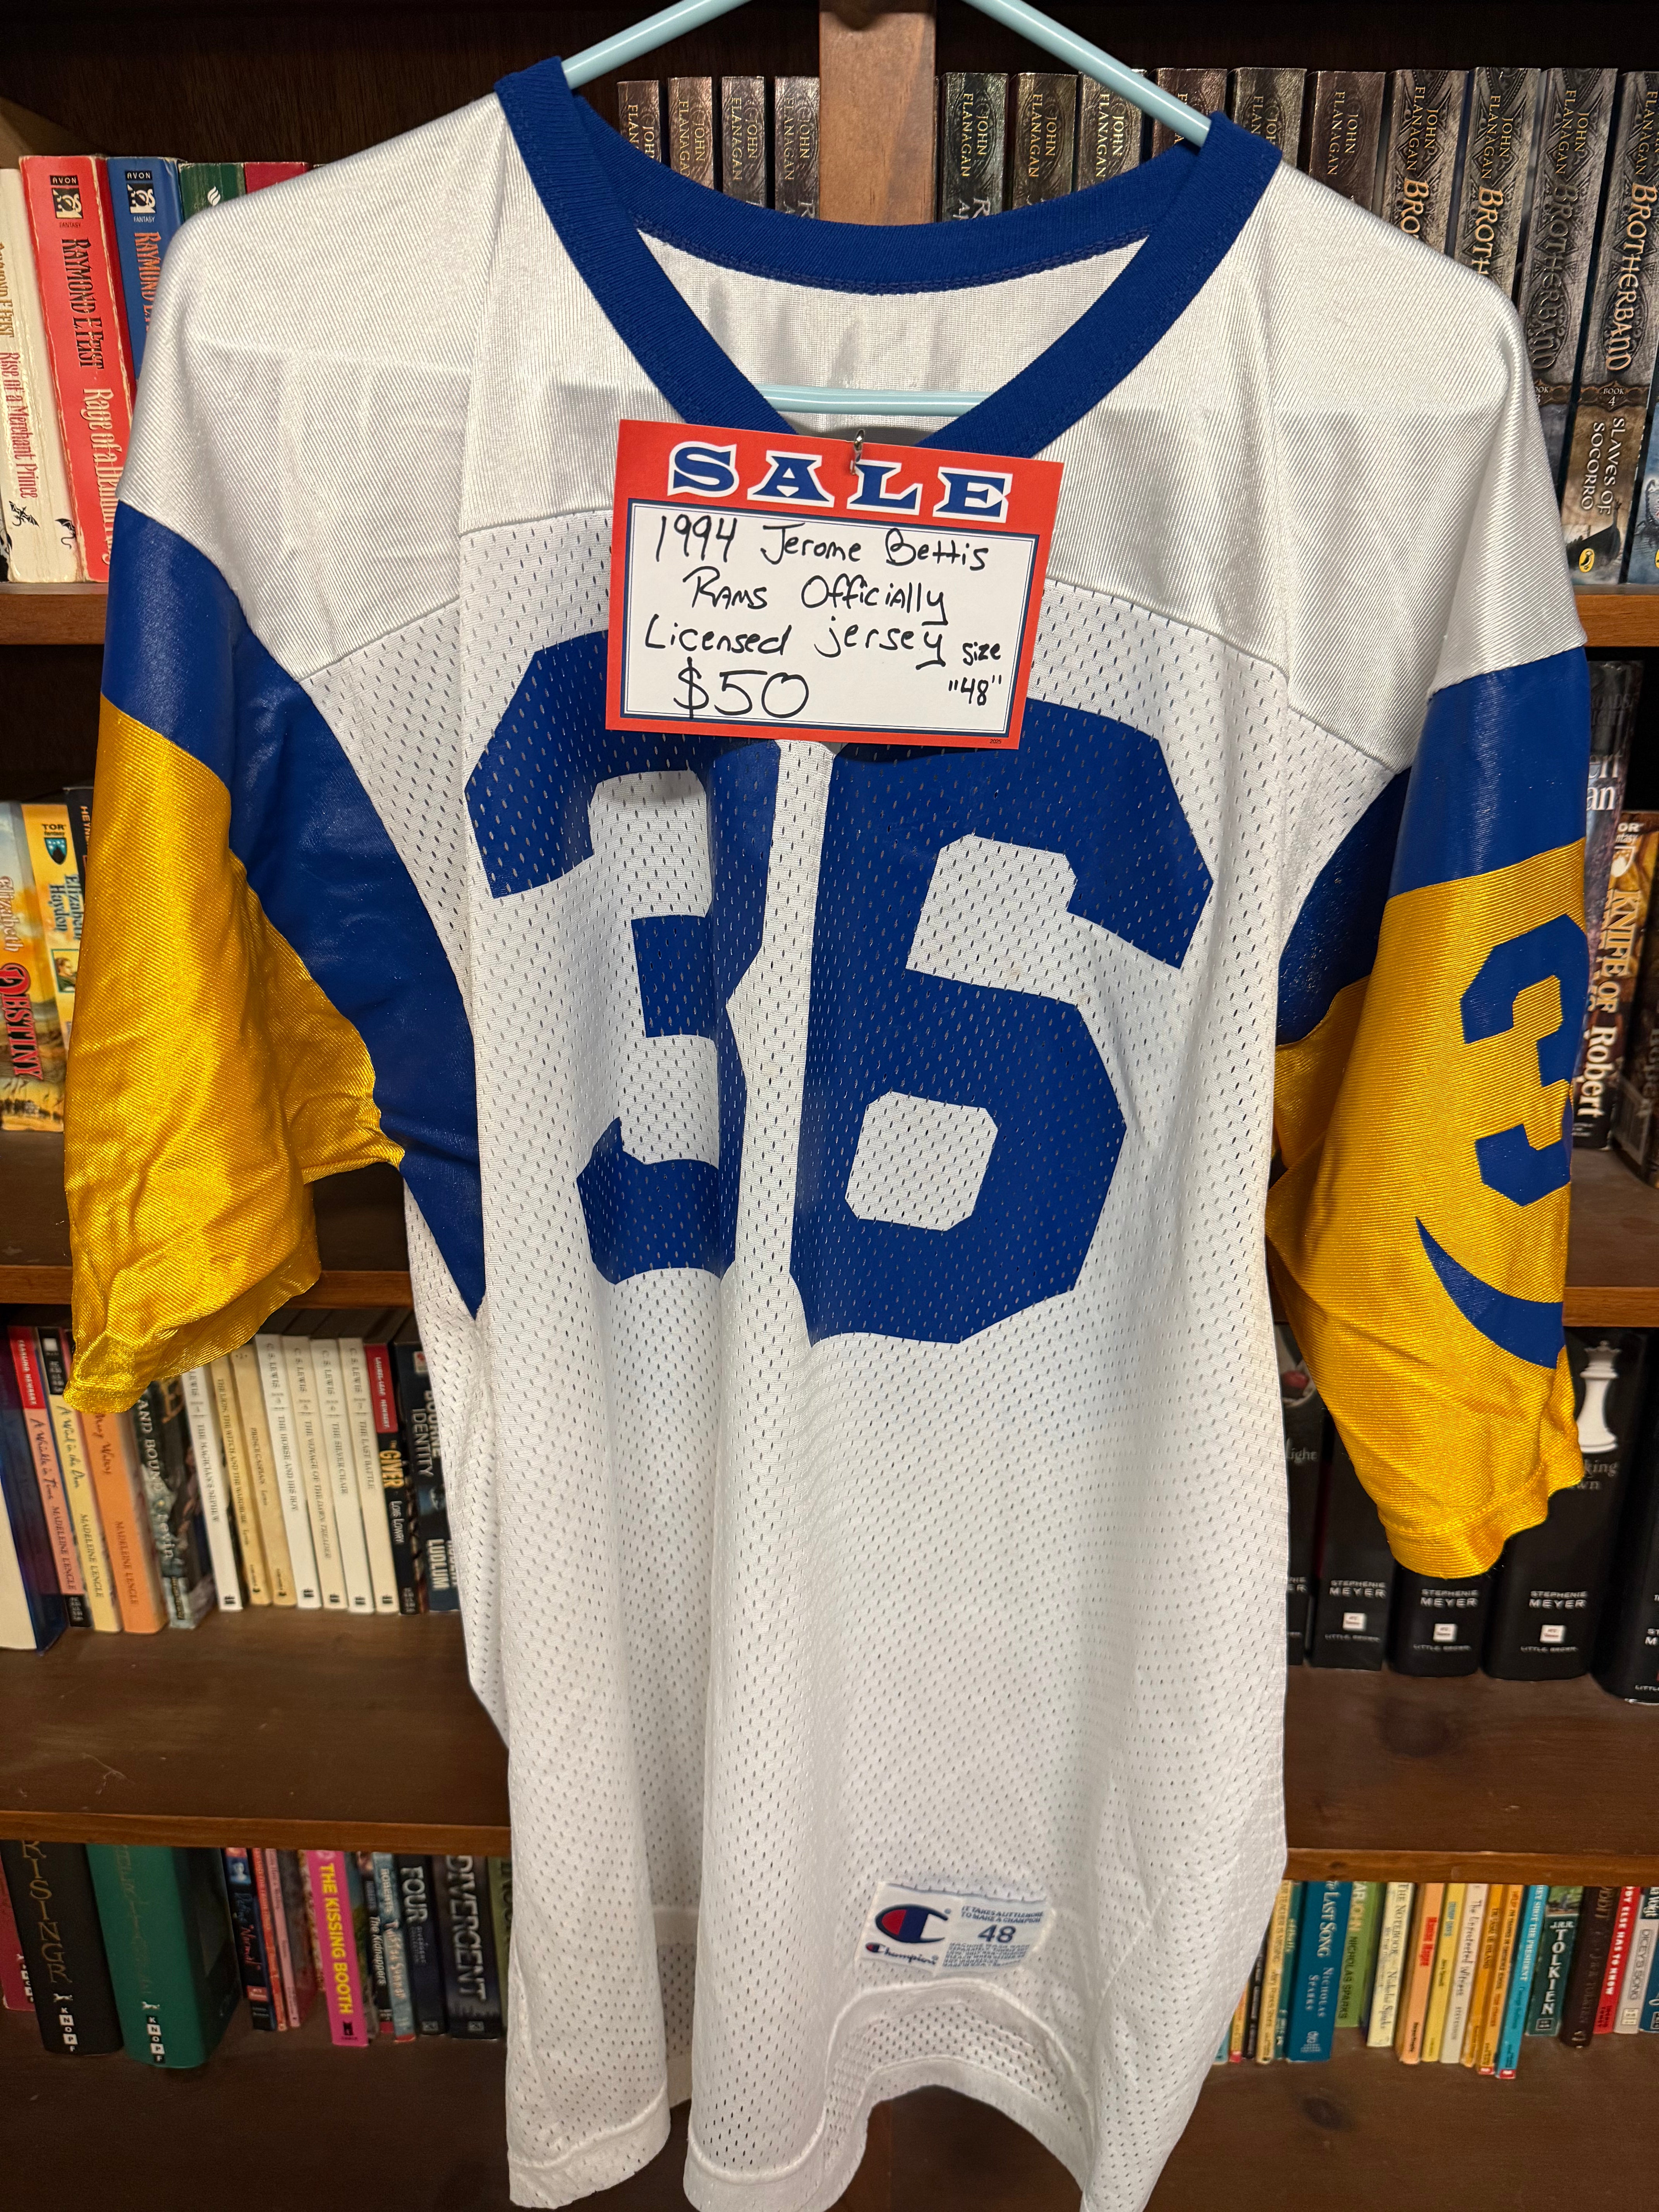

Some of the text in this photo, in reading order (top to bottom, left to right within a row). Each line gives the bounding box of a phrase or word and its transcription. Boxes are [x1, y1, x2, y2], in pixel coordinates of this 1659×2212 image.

[642, 126, 654, 159] JOH
[692, 122, 705, 161] JOHN
[731, 97, 742, 180] FLANAGAN
[745, 118, 758, 160] JOHN
[784, 98, 795, 180] FLANAGAN
[797, 118, 810, 159] JOHN
[961, 93, 973, 177] FLANAGAN
[976, 115, 988, 156] JOHN
[1028, 93, 1043, 178] FLANAGAN
[1045, 116, 1057, 156] JOHN
[1095, 93, 1110, 178] FLANAGAN
[1112, 116, 1125, 156] JOHN
[1327, 91, 1345, 175] FLANAGAN
[1344, 115, 1358, 154] JOHN
[1406, 87, 1425, 172] FLANAGAN
[1424, 109, 1438, 149] JOHN
[1481, 96, 1501, 179] FLANAGAN
[1499, 118, 1513, 158] JOHN
[1556, 90, 1576, 175] FLANAGAN
[1575, 113, 1589, 154] JOHN
[1636, 91, 1658, 175] FLANAGAN
[62, 237, 96, 313] RAYMOND
[134, 232, 161, 301] RAYMOND
[1530, 186, 1578, 369] BROTHERBAND
[1605, 182, 1658, 371] BROTHERBAND
[0, 352, 38, 498] Rise of a Merchant Prince
[81, 388, 122, 462] Rage of a
[1608, 396, 1616, 406] 4
[667, 441, 1013, 523] SALE
[1582, 422, 1605, 510] SOCORRO
[1597, 418, 1625, 515] SLAVES OF
[656, 515, 989, 571] 1994 Jerome Bettis
[645, 614, 1002, 671] Licensed jersey size
[673, 657, 809, 719] $50
[48, 884, 68, 932] Haydon
[1601, 890, 1641, 978] KNIFE
[464, 631, 1213, 1346] 36
[0, 962, 43, 1080] DESTINY
[1577, 1026, 1617, 1118] Robert
[26, 1374, 36, 1405] NEWBERY
[270, 1362, 280, 1388] LEWIS
[297, 1367, 307, 1392] LEWIS
[325, 1369, 335, 1395] LEWIS
[353, 1367, 362, 1393] LEWIS
[374, 1357, 390, 1428] LAUREL-LEAF NEWBERY
[62, 1417, 76, 1444] Wind
[137, 1399, 153, 1434] AND
[197, 1424, 206, 1439] THE
[331, 1423, 340, 1438] THE
[278, 1415, 299, 1511] THE HORSE AND HIS BOY
[307, 1439, 318, 1470] VOYAGE
[334, 1440, 345, 1466] SILVER
[359, 1421, 375, 1491] THE LAST BATTLE
[412, 1408, 434, 1477] IDENTITY
[380, 1450, 405, 1489] GIVER
[52, 1506, 67, 1559] MADELEINE
[80, 1514, 96, 1563] MADELEINE
[115, 1521, 132, 1571] MADELEINE
[427, 1539, 450, 1590] LUDLUM
[1331, 1580, 1386, 1588] STEPHENIE
[1329, 1587, 1387, 1599] MEYER
[1420, 1597, 1479, 1608] MEYER
[1421, 1589, 1480, 1597] STEPHENIE
[1529, 1599, 1587, 1609] MEYER
[1530, 1590, 1587, 1599] STEPHENIE
[22, 1841, 72, 1983] RISINGR
[401, 1866, 428, 1924] FOUR
[1349, 1901, 1365, 1932] JOHN
[1391, 1884, 1409, 1954] THE NOTEBOOK
[1470, 1899, 1482, 1913] The
[318, 1863, 354, 2015] THE KISSING BOOTH
[447, 1855, 487, 2001] DIVERGENT
[977, 1924, 1016, 1943] 48
[1317, 1892, 1341, 1958] LAST SONG
[1605, 1906, 1631, 1995] ELSE HAS TO KNOW
[369, 1916, 386, 1986] The Kidnappers
[866, 1942, 936, 1965] Champion
[1520, 1938, 1535, 1982] PRESIDENT
[1542, 1929, 1568, 2015] TOLKIEN
[1628, 1930, 1653, 2001] DICEY'S SONG
[1305, 1975, 1319, 2011] SPARKS
[1318, 1967, 1334, 2018] NICHOLAS
[1338, 1937, 1357, 2019] NICHOLAS SPARKS
[59, 2007, 78, 2052] KNOPF
[147, 2016, 165, 2062] KNOPF
